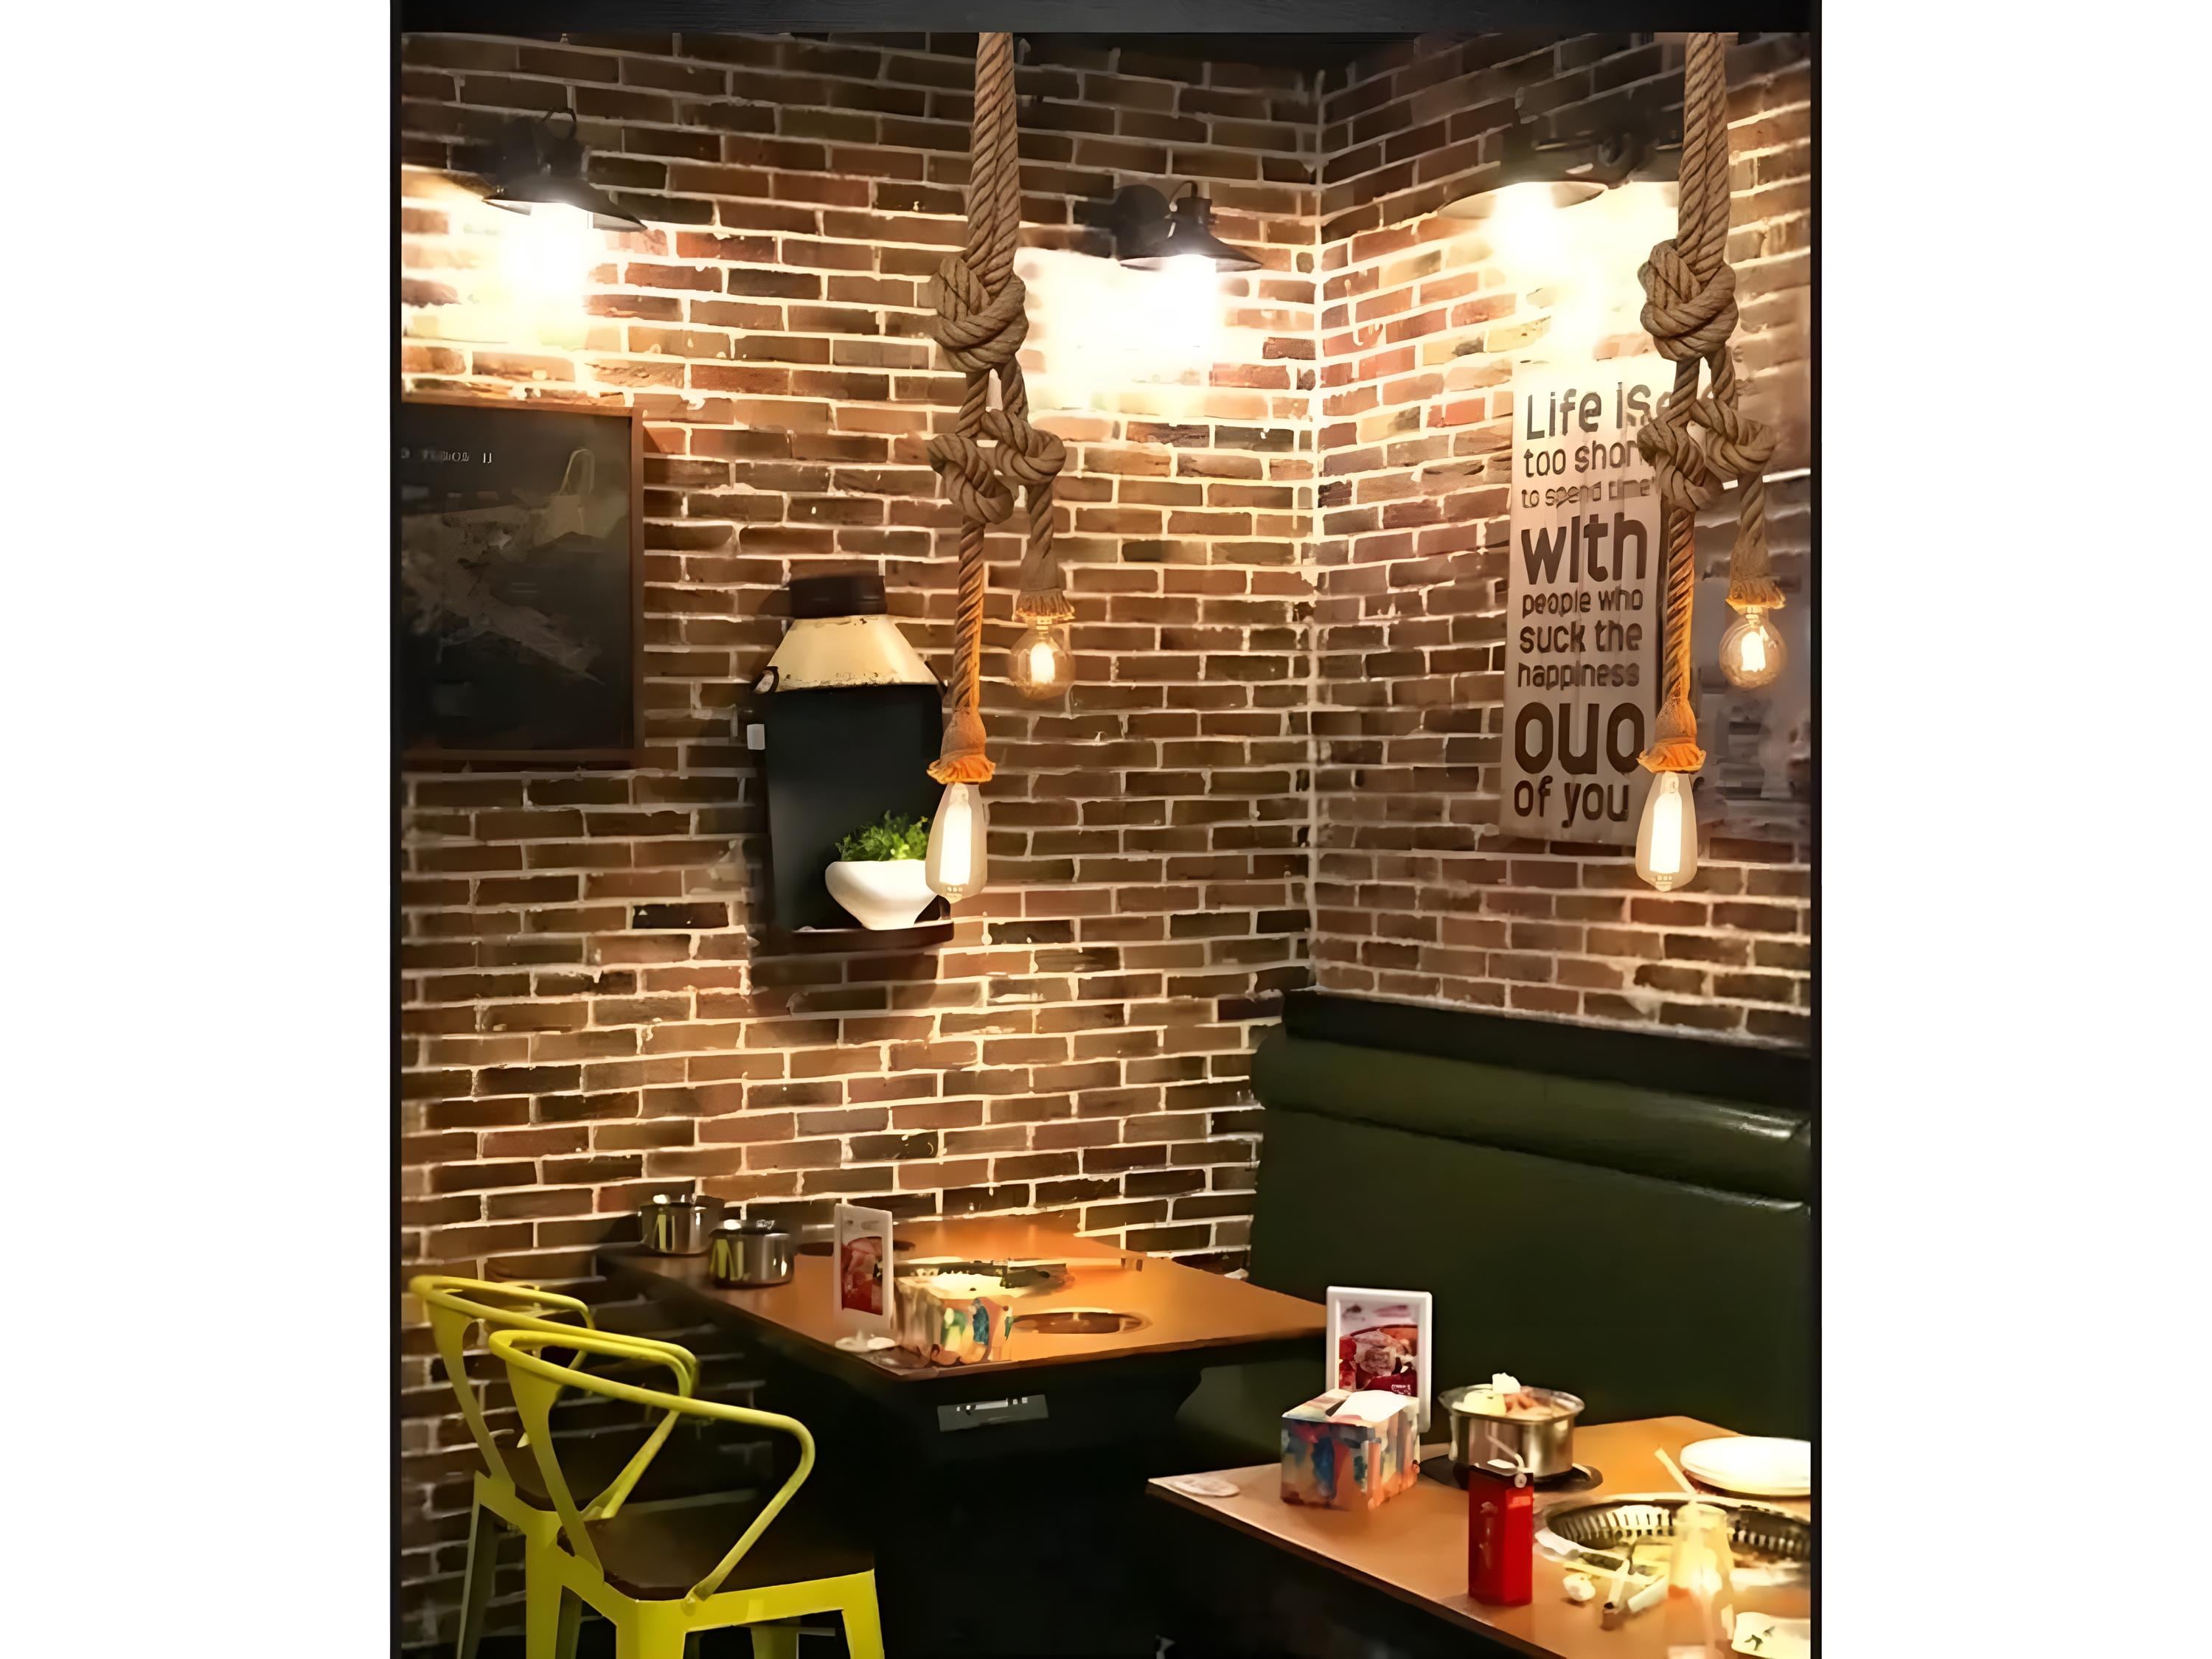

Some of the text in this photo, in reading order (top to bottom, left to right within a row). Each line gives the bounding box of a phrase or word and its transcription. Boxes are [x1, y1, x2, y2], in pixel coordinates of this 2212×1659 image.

[1526, 388, 1601, 440] Life
[1523, 448, 1566, 478] too
[1521, 489, 1540, 508] to
[1523, 585, 1643, 619] people who
[1520, 620, 1642, 653] suck the
[1518, 661, 1640, 690] happiness
[1514, 776, 1628, 828] of you
